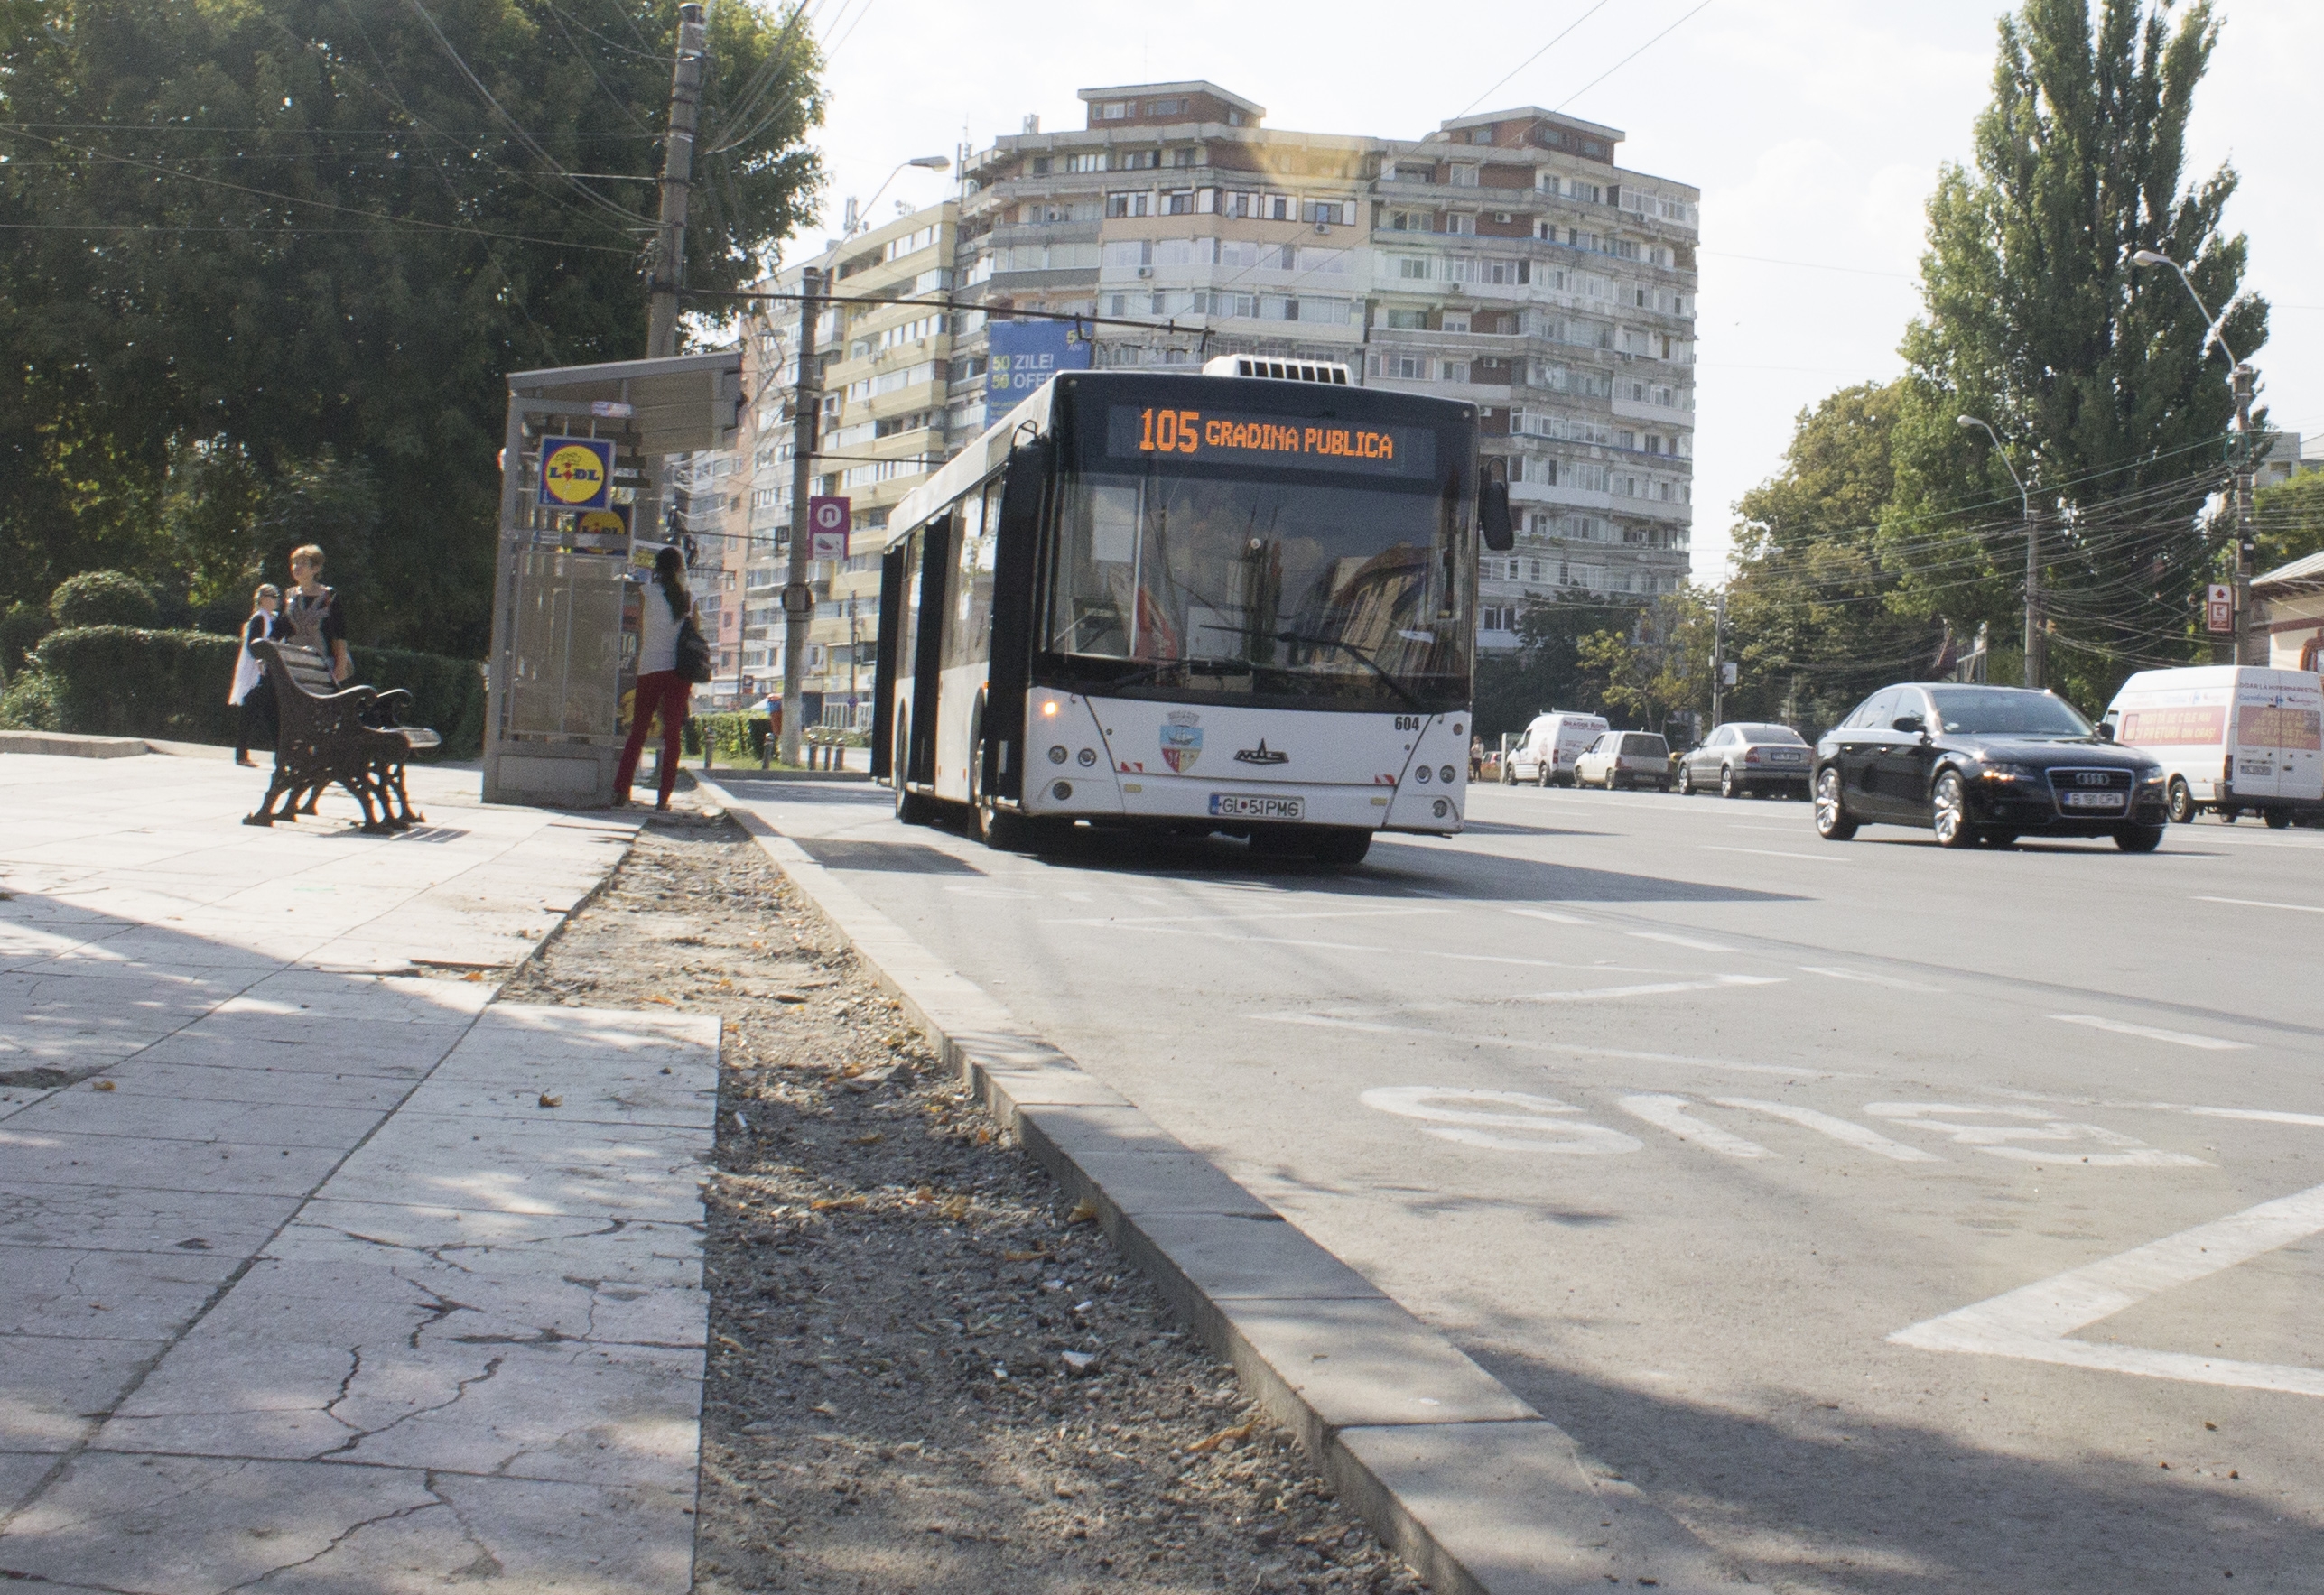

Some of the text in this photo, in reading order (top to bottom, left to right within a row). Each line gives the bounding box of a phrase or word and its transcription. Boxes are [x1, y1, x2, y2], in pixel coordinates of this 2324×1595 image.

[992, 355, 1010, 371] 50
[991, 373, 1009, 389] 50
[1139, 408, 1393, 459] 105 GRADINA PUBLICA
[548, 461, 600, 481] LIDL
[1394, 716, 1420, 731] 604
